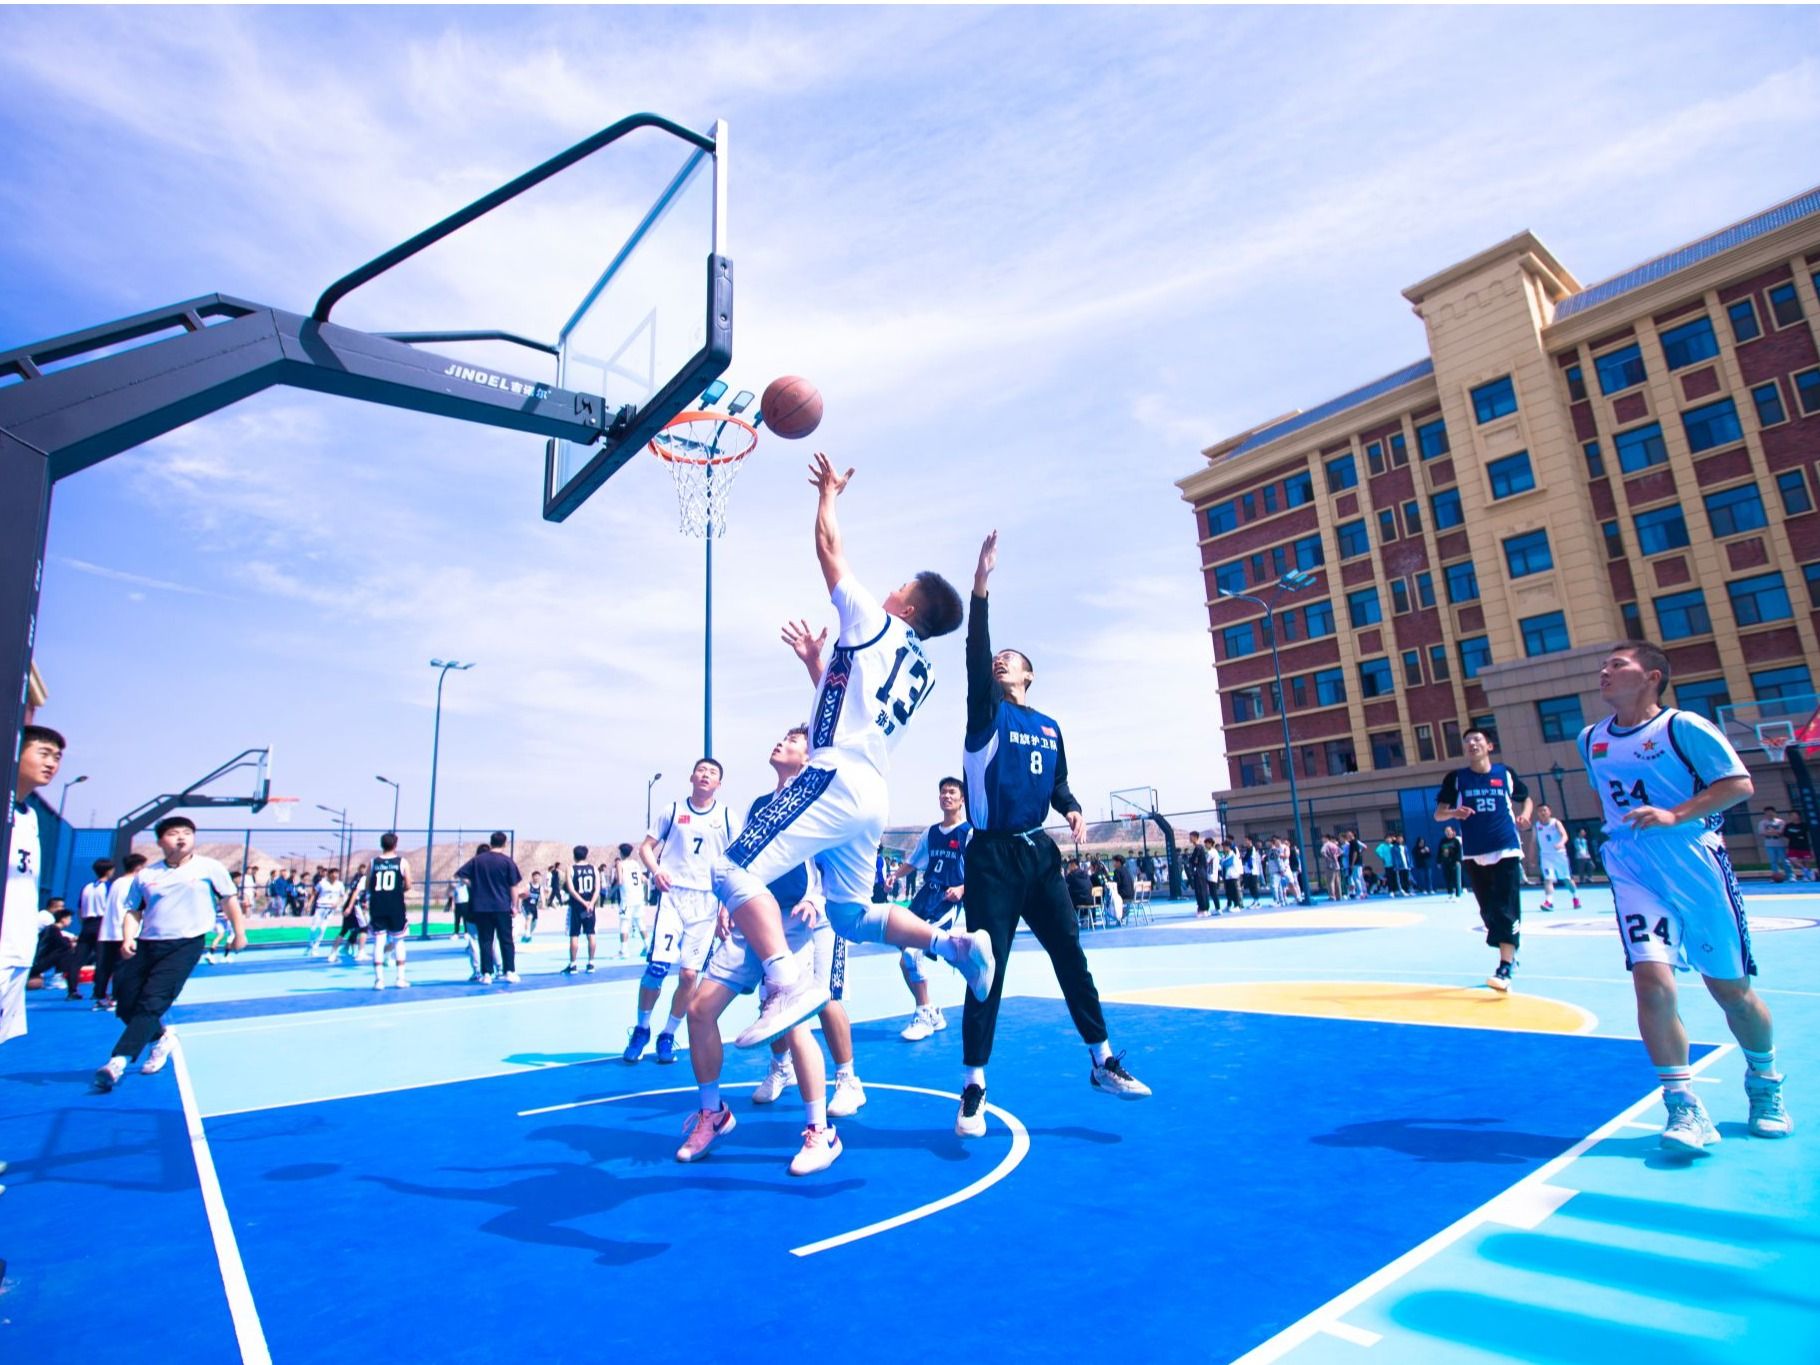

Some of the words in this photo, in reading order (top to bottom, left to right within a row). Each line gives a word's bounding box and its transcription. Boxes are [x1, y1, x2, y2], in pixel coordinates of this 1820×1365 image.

[875, 646, 928, 726] 13
[1030, 750, 1043, 775] 8
[1608, 779, 1653, 807] 24
[1476, 797, 1497, 812] 25
[693, 837, 704, 855] 7
[375, 870, 396, 891] 10
[578, 875, 593, 894] 10
[1625, 913, 1672, 947] 24
[664, 933, 674, 952] 7
